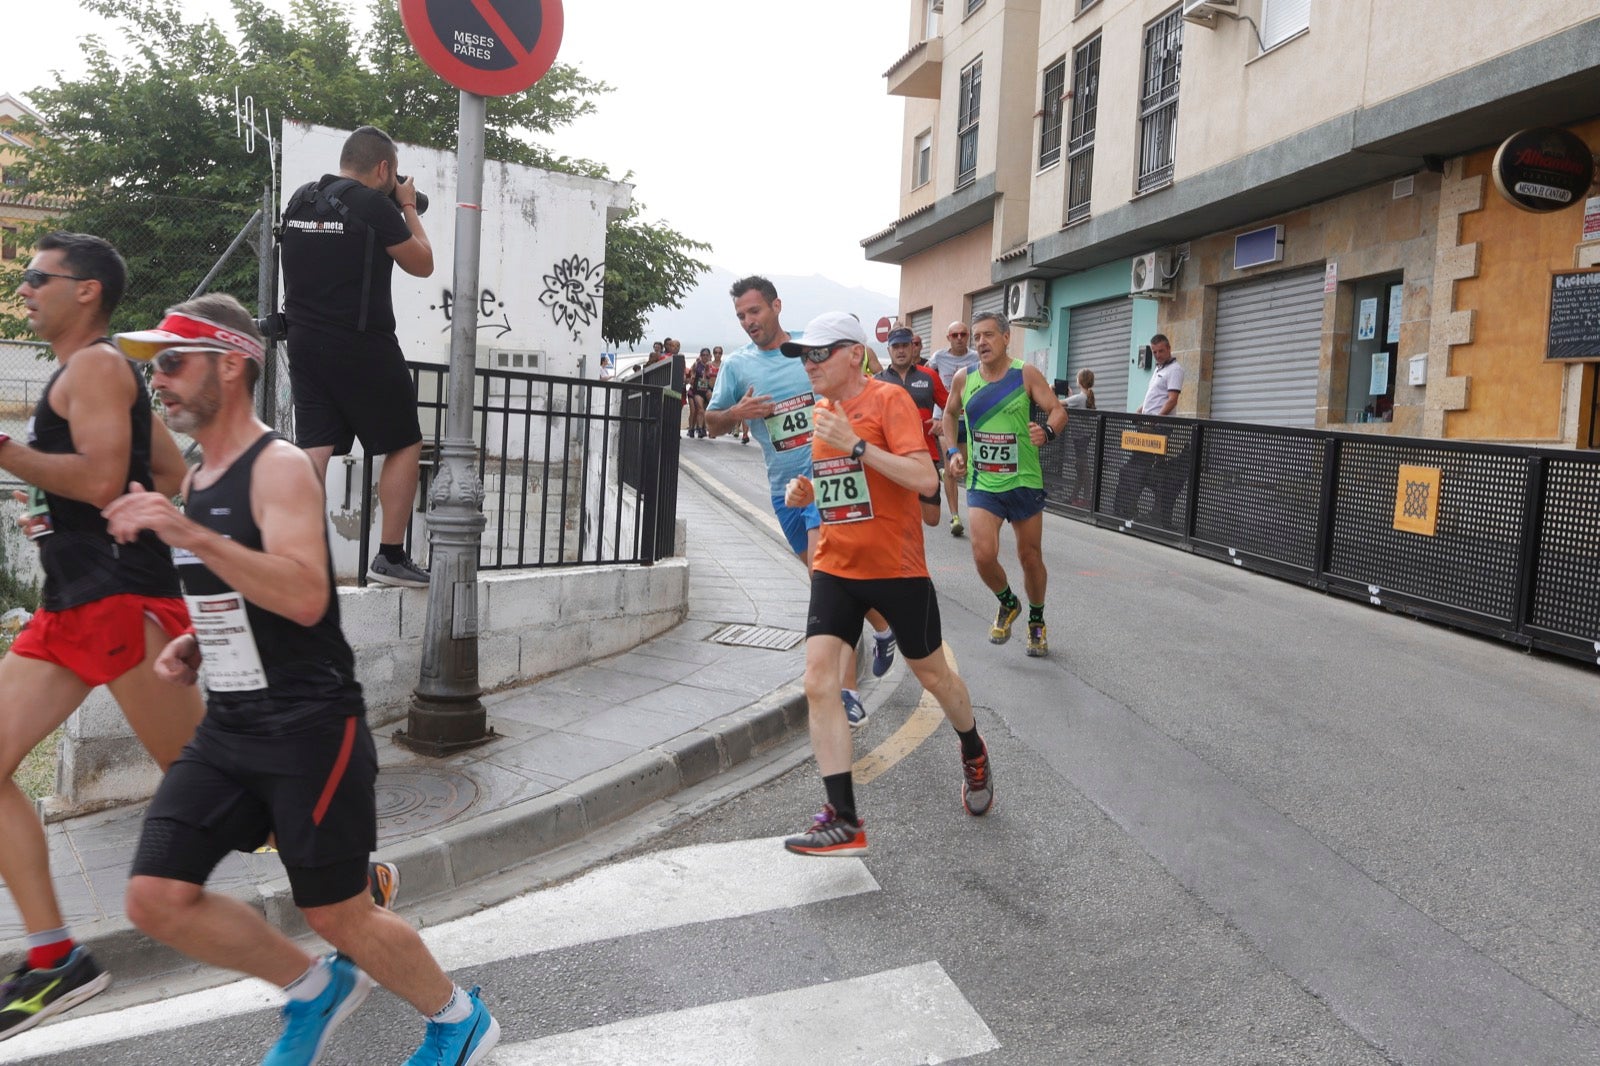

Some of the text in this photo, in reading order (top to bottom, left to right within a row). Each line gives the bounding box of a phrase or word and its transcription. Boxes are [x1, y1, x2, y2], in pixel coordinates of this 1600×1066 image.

[454, 30, 494, 48] MESES
[453, 43, 491, 60] PARES
[782, 411, 808, 433] 48
[979, 445, 1010, 461] 675
[820, 476, 858, 503] 278
